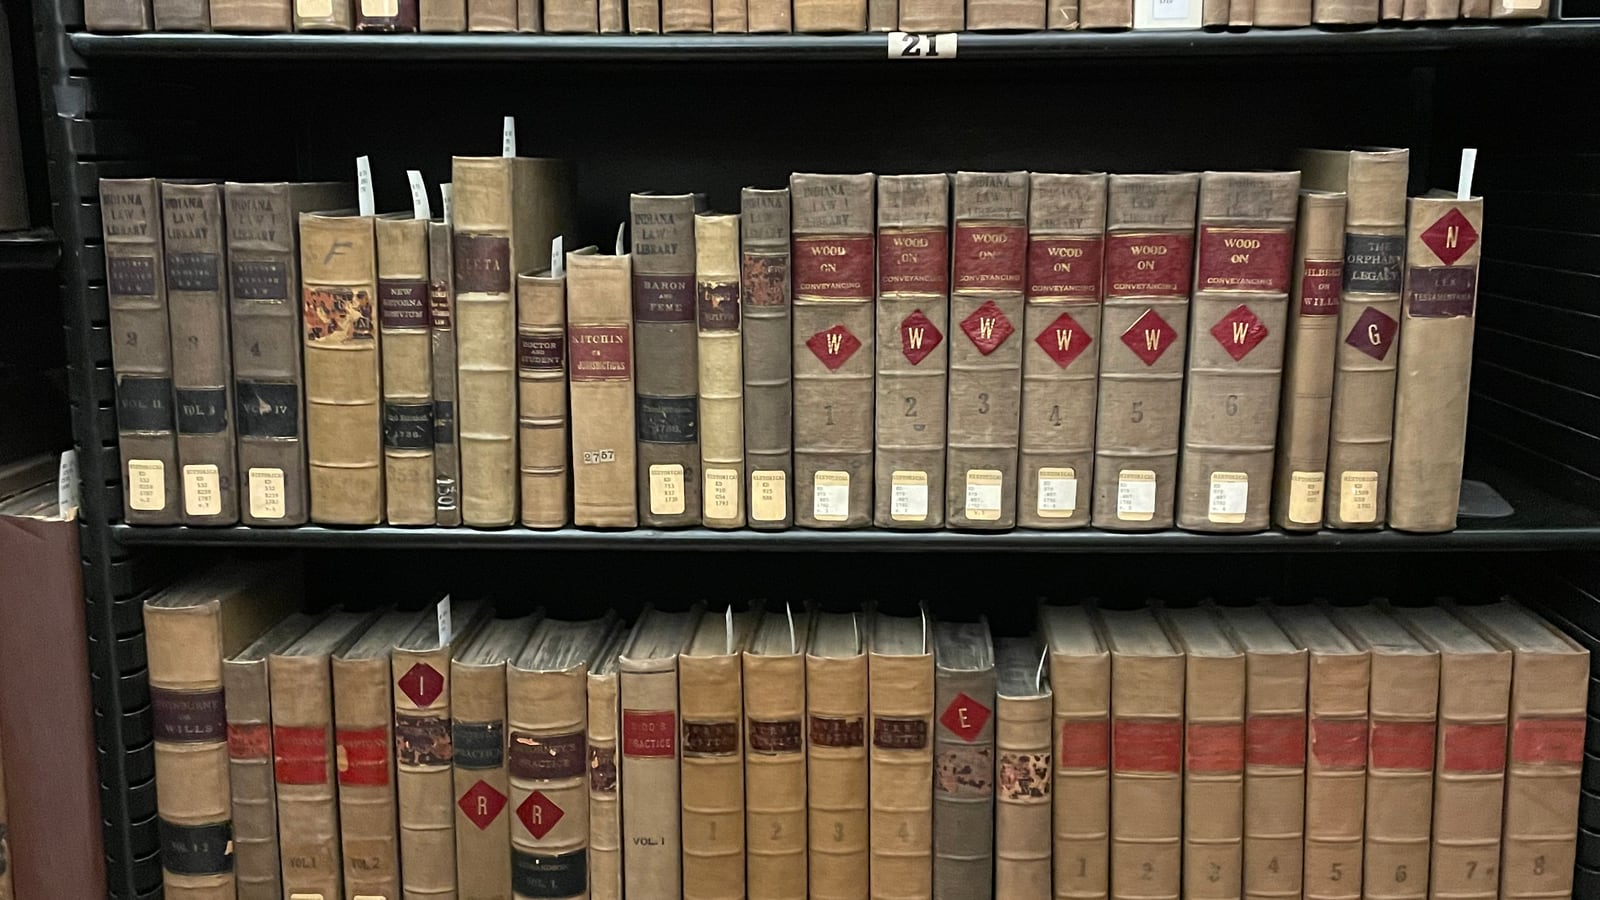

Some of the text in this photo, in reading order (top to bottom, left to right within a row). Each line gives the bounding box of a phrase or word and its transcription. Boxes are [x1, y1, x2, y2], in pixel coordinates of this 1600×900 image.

[901, 35, 939, 57] 21
[973, 177, 1010, 188] DIANA
[746, 198, 784, 209] DIANA
[635, 214, 675, 225] INDIANA
[106, 224, 148, 236] LIBRARY
[972, 234, 1007, 243] WOOD
[1446, 226, 1459, 248] N
[636, 244, 678, 255] LIBRARY
[811, 247, 846, 256] WOOD
[893, 238, 928, 247] WOOD
[1131, 246, 1167, 256] WOOD
[1224, 239, 1260, 249] WOOD
[1369, 242, 1392, 251] THE
[323, 241, 353, 265] F
[902, 254, 917, 263] ON
[979, 251, 994, 259] ON
[1048, 248, 1083, 258] WOOD
[1231, 254, 1249, 264] ON
[458, 258, 501, 271] LETA
[820, 264, 836, 272] ON
[1054, 263, 1071, 272] ON
[1137, 261, 1155, 270] ON
[644, 281, 686, 290] BARON
[801, 282, 861, 290] CONVEYANCING
[1207, 277, 1273, 286] CONVEYANCING
[391, 288, 412, 296] NEW
[650, 304, 682, 312] FEME
[979, 317, 995, 339] W
[1233, 322, 1248, 344] W
[1368, 324, 1381, 345] G
[572, 334, 624, 344] KITCHIN
[827, 333, 842, 354] W
[909, 327, 924, 349] W
[1056, 329, 1072, 350] W
[1145, 329, 1160, 350] W
[521, 356, 560, 364] STUDENT
[905, 397, 917, 417] 2
[979, 393, 990, 414] 3
[1131, 401, 1144, 423] 5
[1225, 394, 1238, 416] 6
[823, 405, 834, 426] 1
[1050, 405, 1062, 426] 4
[584, 451, 615, 463] 2757
[420, 676, 424, 696] I
[958, 708, 971, 728] E
[165, 724, 213, 734] WILLS
[478, 796, 487, 815] R
[533, 805, 542, 825] R
[710, 822, 717, 841] 1
[771, 822, 782, 841] 2
[833, 822, 845, 842] 3
[1078, 857, 1087, 877] 1
[1142, 862, 1154, 881] 2
[1209, 863, 1221, 883] 3
[1268, 856, 1280, 873] 4
[1331, 863, 1342, 881] 5
[1395, 864, 1407, 883] 6
[1466, 861, 1477, 879] 7
[1533, 856, 1545, 875] 8
